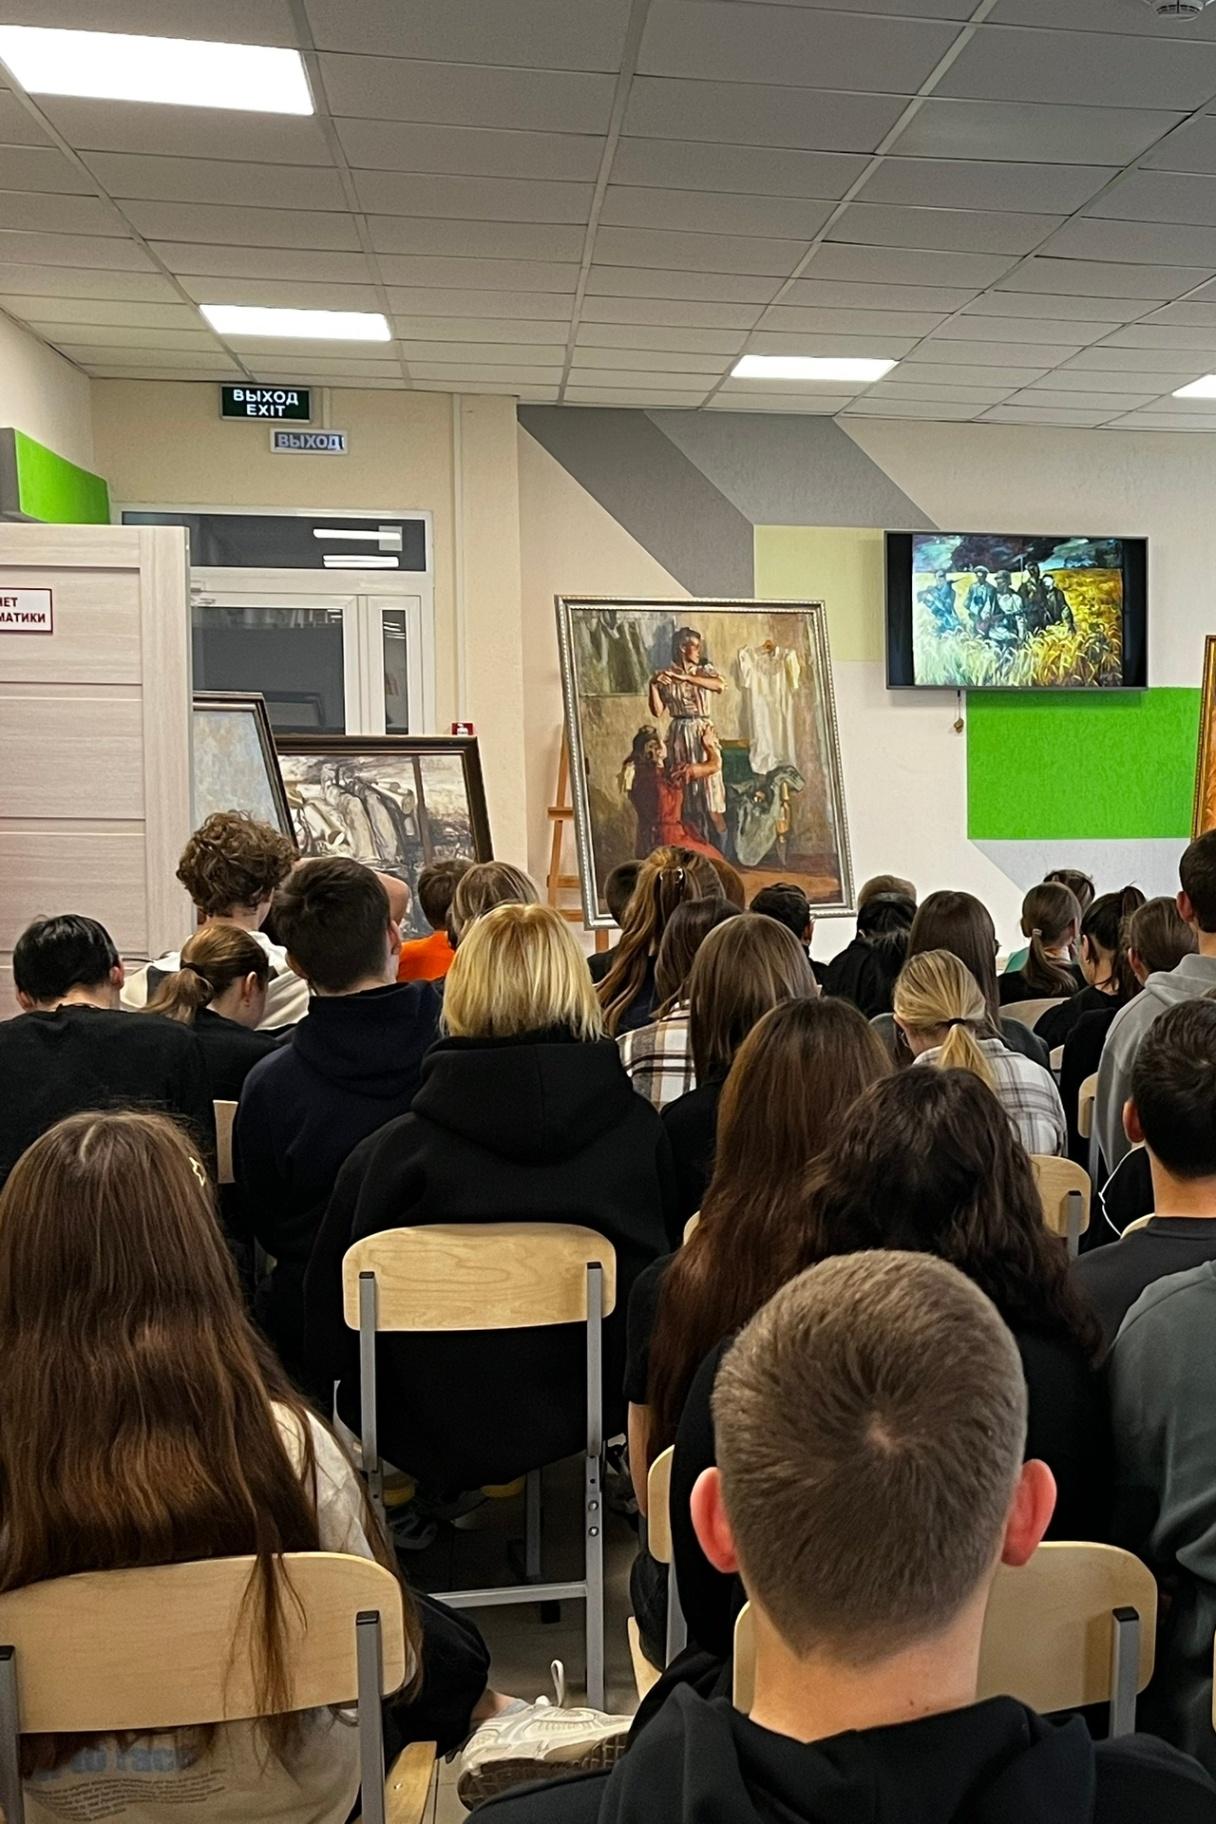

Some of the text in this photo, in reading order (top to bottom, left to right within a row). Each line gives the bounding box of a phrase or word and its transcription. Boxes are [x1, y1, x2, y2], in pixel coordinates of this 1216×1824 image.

[233, 389, 299, 406] ВЫХОД
[246, 403, 286, 417] EXIT
[277, 434, 341, 450] ВЫХОД
